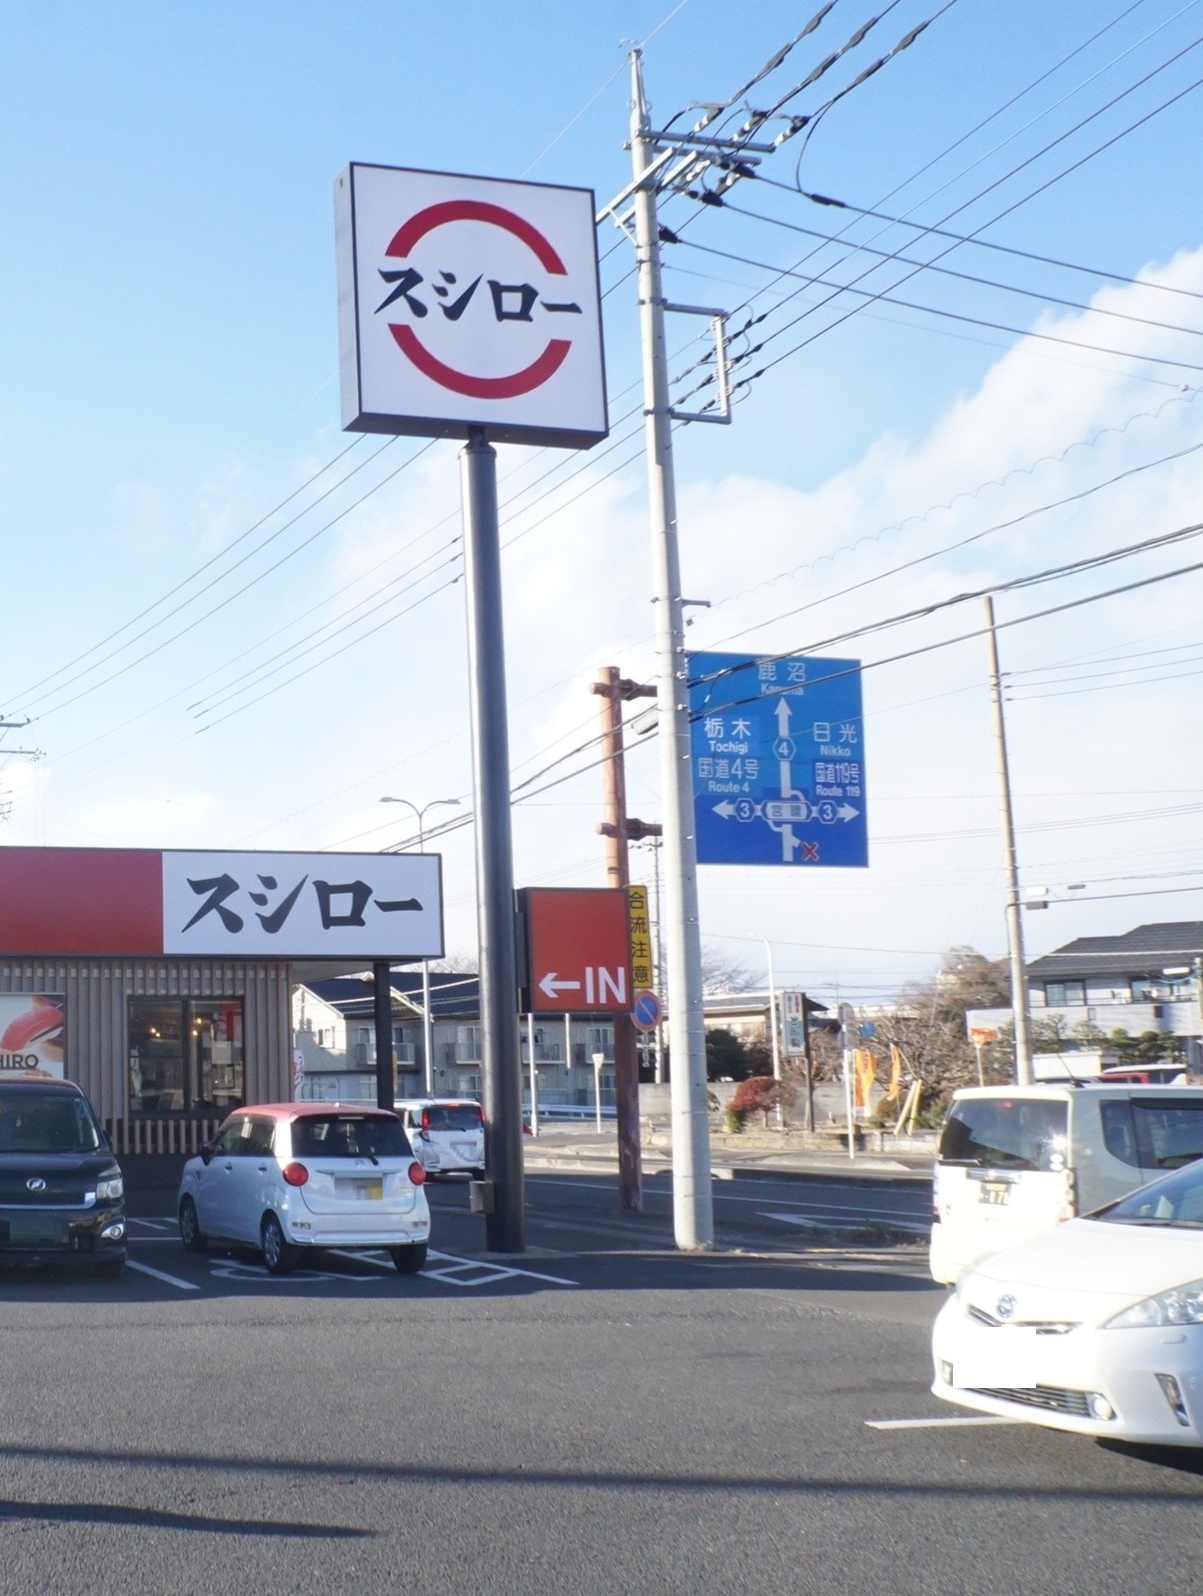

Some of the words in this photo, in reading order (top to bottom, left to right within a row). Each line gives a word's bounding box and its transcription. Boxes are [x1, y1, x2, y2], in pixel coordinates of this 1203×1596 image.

[374, 267, 583, 322] スシロー
[758, 661, 806, 682] 鹿沼
[704, 717, 751, 739] 栃木
[813, 722, 858, 743] 日光
[708, 740, 749, 755] Tochigi
[778, 742, 788, 756] 4
[820, 744, 851, 757] Nikko
[698, 757, 759, 779] 国道4号
[708, 780, 740, 793] Route
[741, 781, 751, 793] 4
[816, 784, 843, 797] Route
[845, 785, 861, 797] 119
[740, 803, 750, 817] 3
[822, 805, 833, 819] 3
[181, 873, 424, 934] スシロー
[630, 891, 650, 983] 合流注意
[585, 966, 627, 1004] IN
